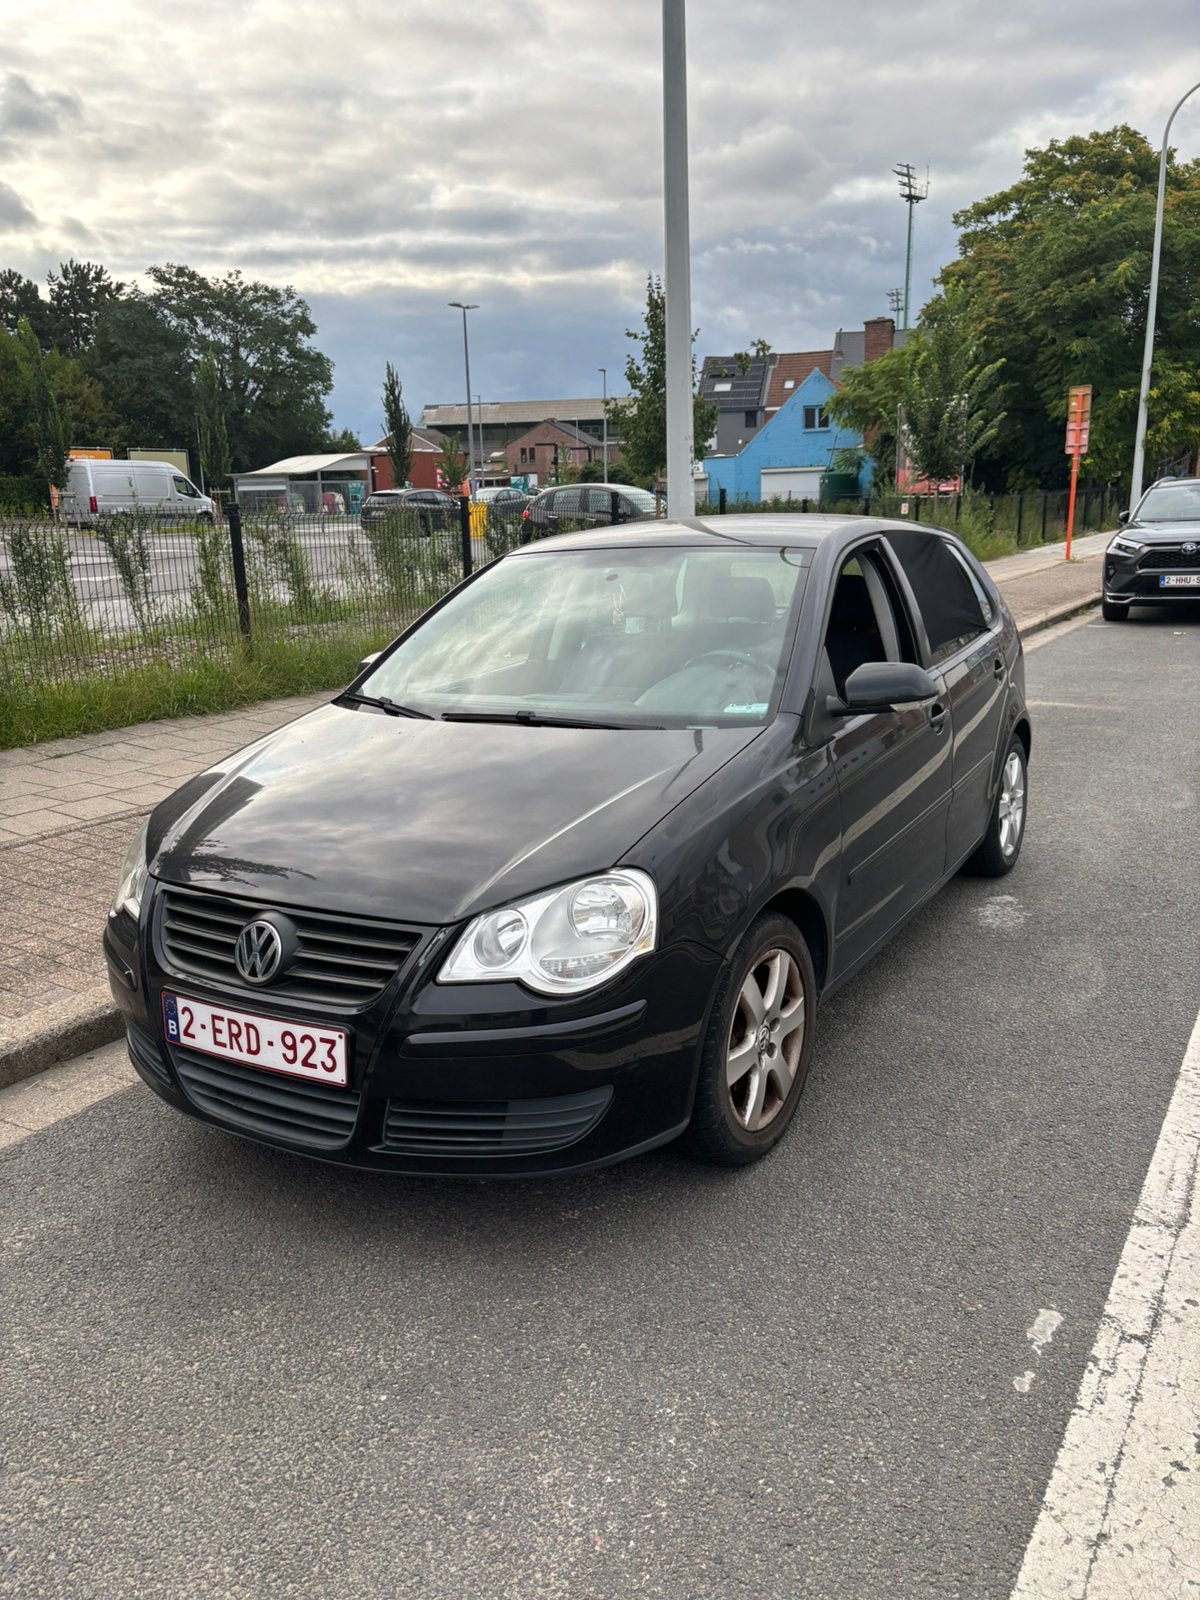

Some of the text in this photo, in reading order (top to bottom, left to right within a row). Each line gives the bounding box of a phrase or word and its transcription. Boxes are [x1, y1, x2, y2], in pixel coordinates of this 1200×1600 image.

[236, 922, 281, 982] VW
[168, 1006, 337, 1073] B 2-ERD-923
